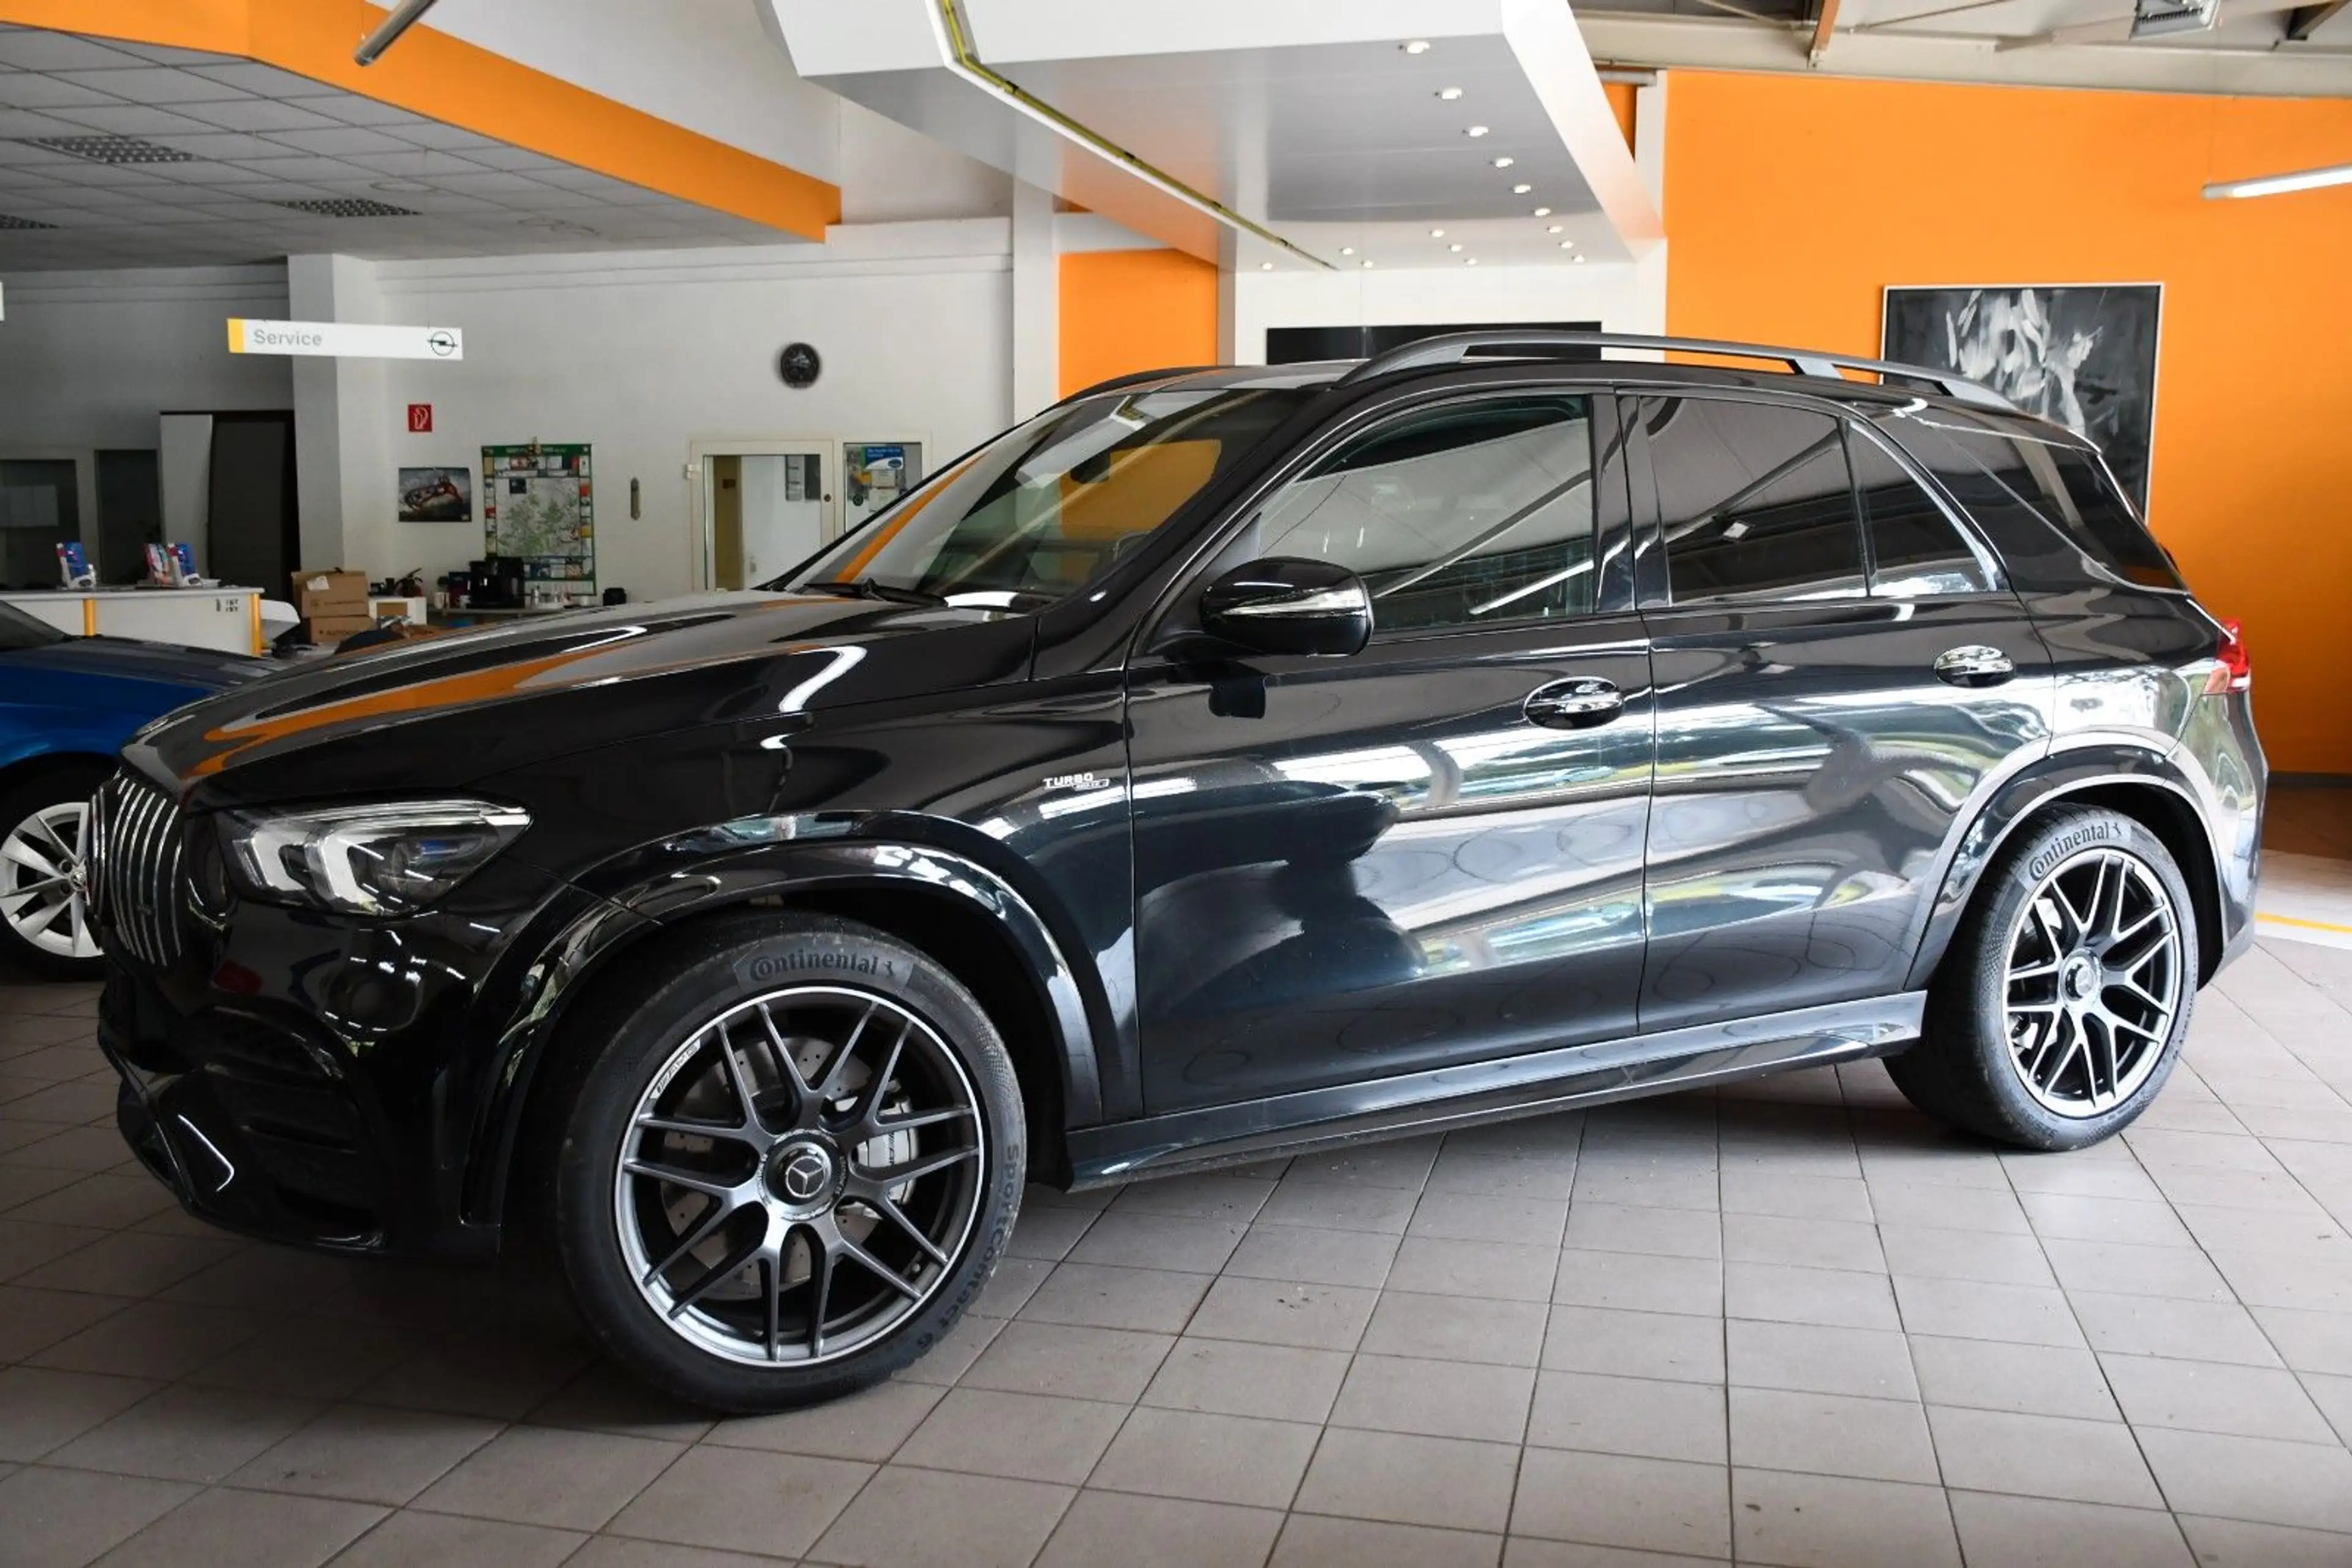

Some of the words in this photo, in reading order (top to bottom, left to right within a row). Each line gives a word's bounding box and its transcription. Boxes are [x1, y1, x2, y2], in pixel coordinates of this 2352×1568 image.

[252, 328, 323, 347] Service
[1042, 771, 1093, 788] TURBO
[2029, 821, 2109, 881] Continental
[750, 949, 879, 981] Continental
[938, 1145, 1020, 1330] SportContact
